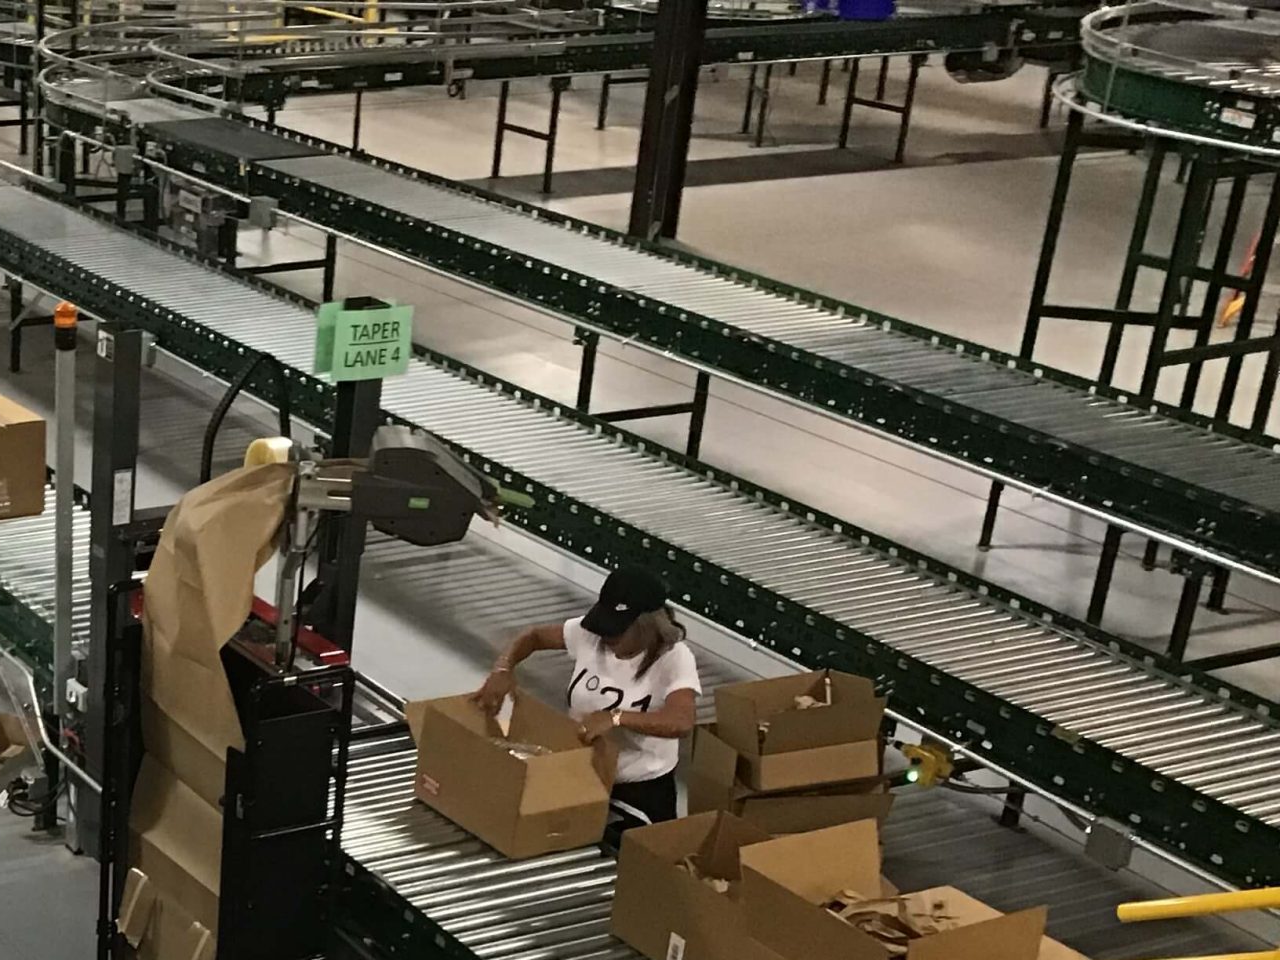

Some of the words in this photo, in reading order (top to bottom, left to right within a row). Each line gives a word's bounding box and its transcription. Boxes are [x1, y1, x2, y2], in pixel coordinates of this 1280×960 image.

[350, 321, 400, 342] TAPER
[344, 348, 388, 368] LANE
[391, 346, 401, 362] 4
